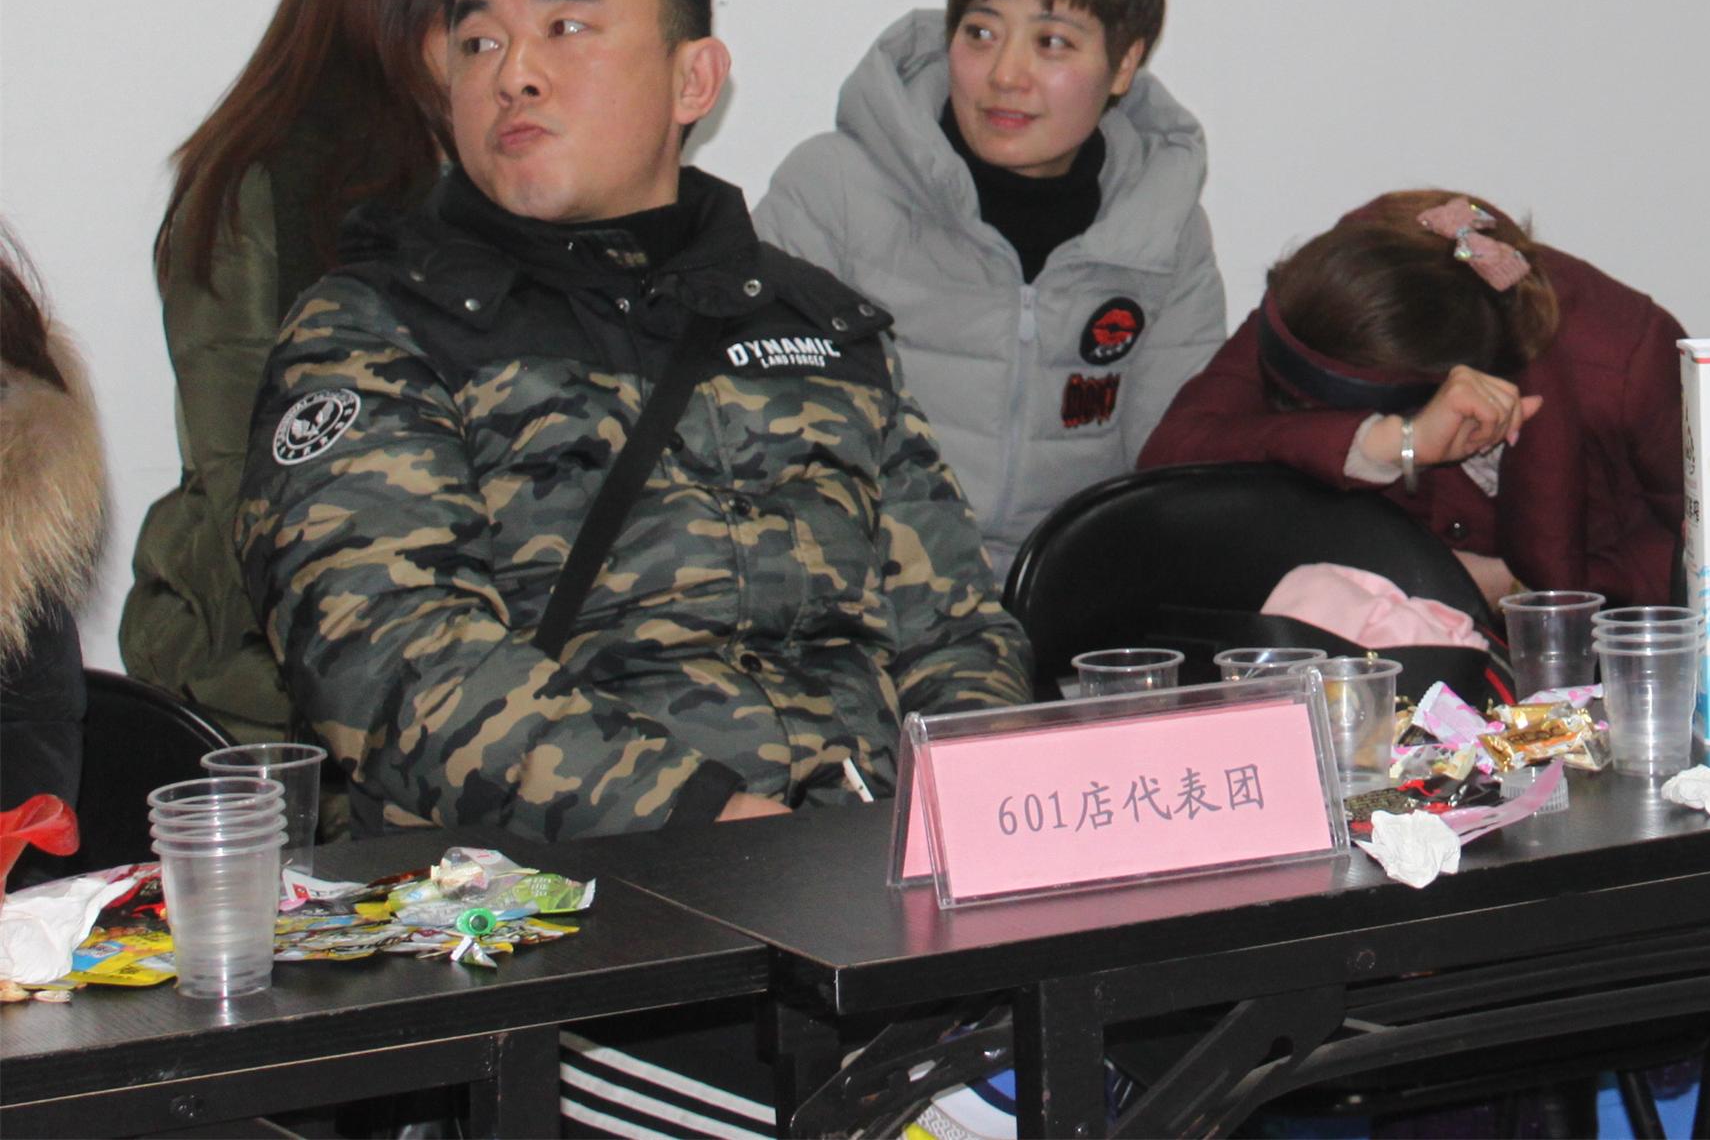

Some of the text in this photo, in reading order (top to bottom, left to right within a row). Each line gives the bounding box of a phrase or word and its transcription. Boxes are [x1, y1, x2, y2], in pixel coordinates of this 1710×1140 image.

[726, 337, 841, 367] DYNAMIC
[760, 355, 789, 369] LAND
[998, 763, 1266, 836] 601店代表团
